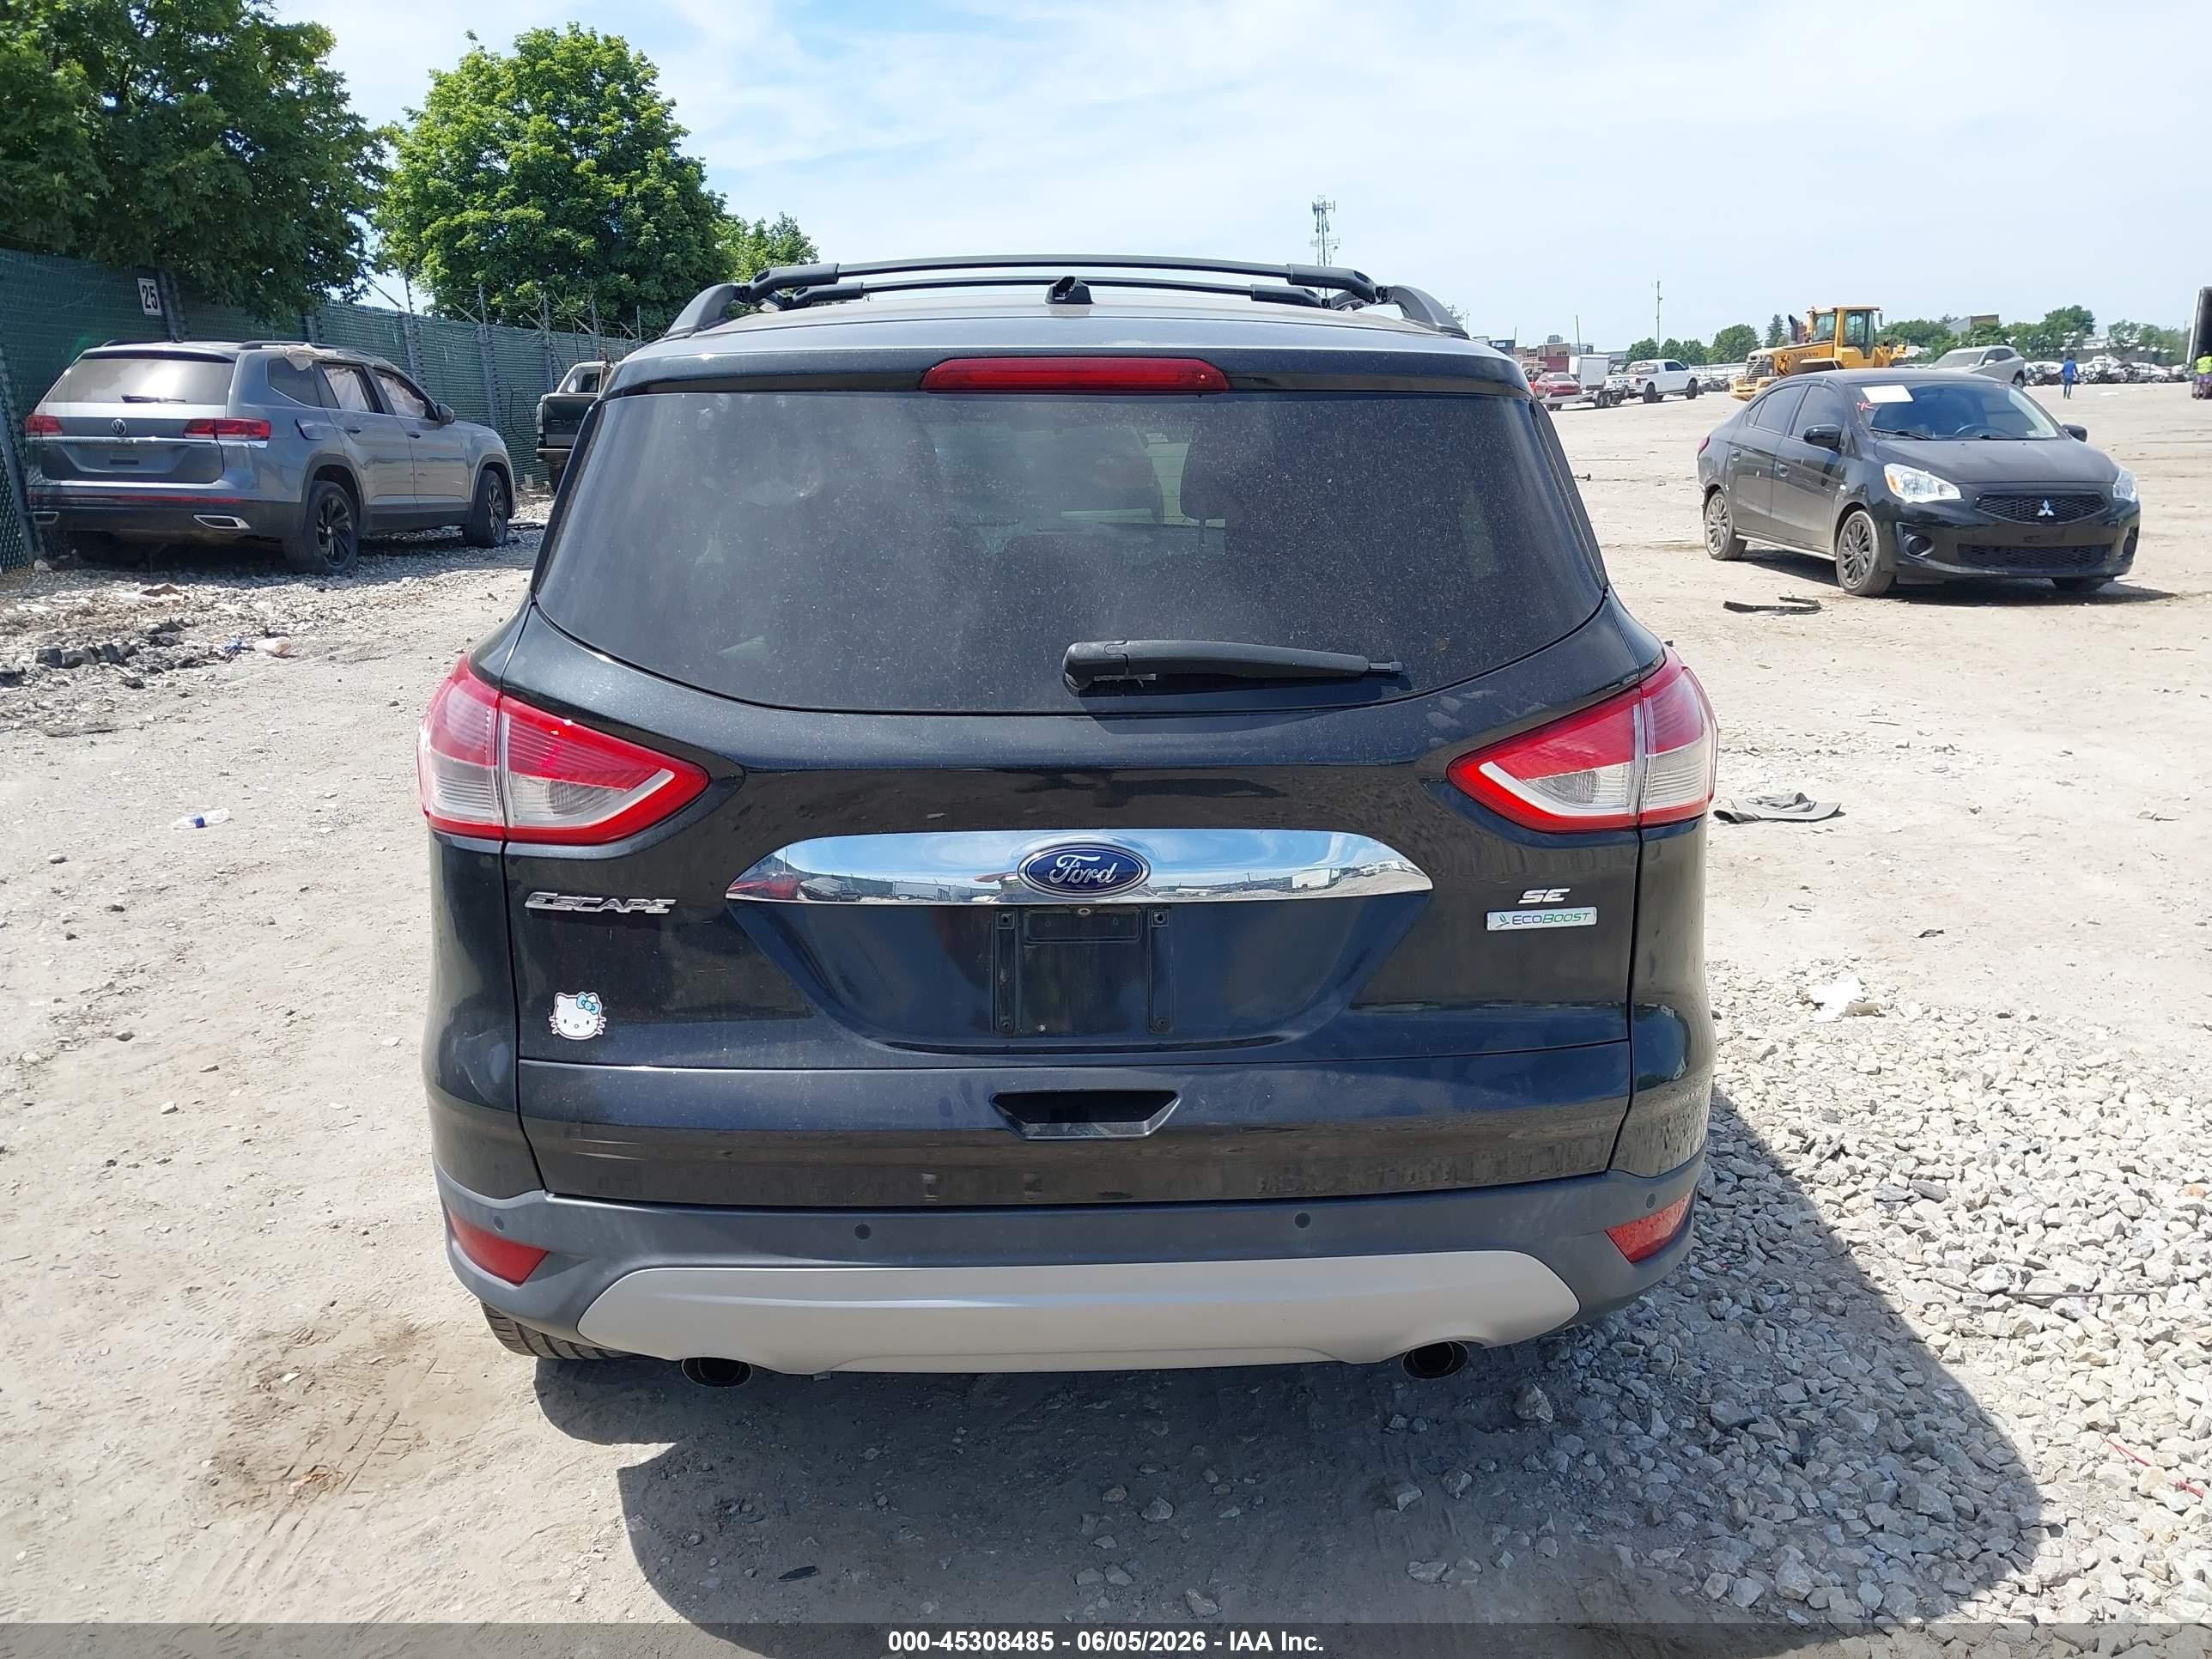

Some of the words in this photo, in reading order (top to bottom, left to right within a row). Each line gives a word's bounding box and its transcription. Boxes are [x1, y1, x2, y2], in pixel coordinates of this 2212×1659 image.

[142, 284, 158, 310] 25
[1048, 854, 1119, 884] Ford
[525, 891, 677, 914] ESCAPE
[1517, 888, 1571, 904] SE
